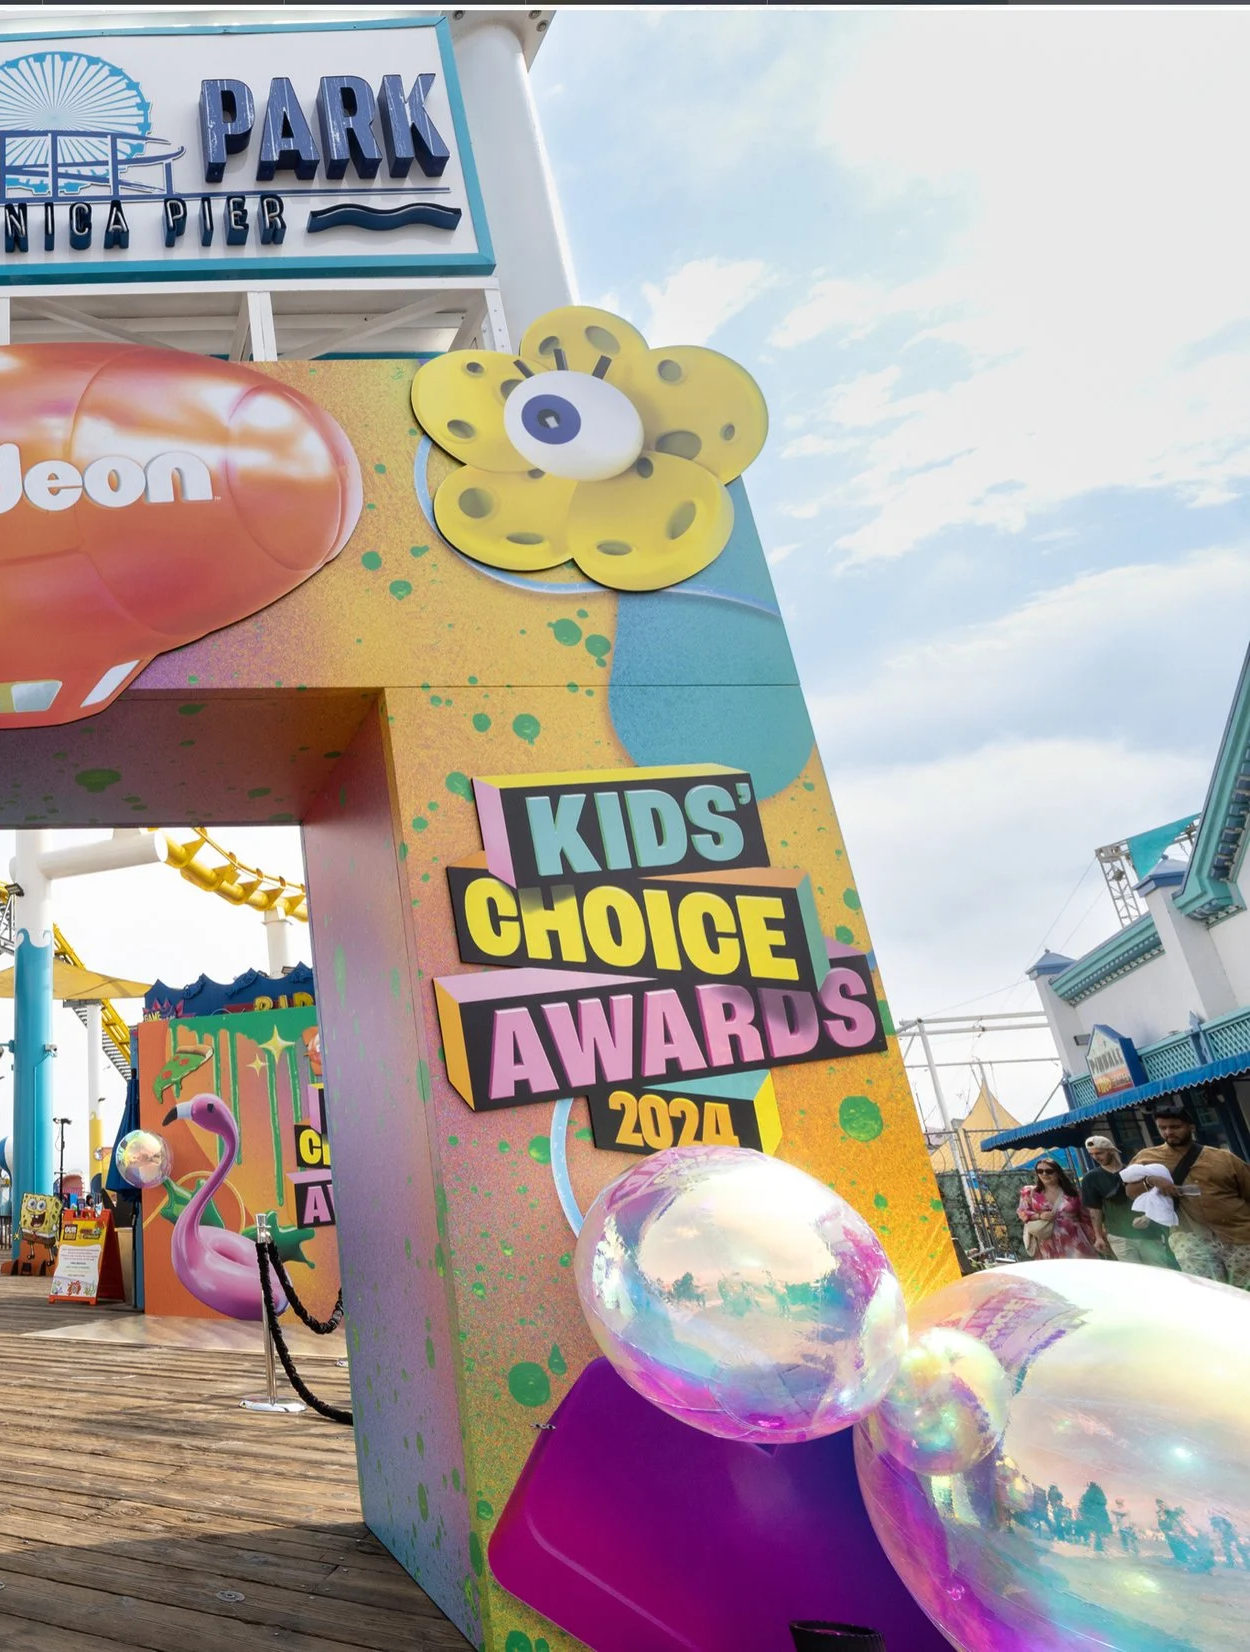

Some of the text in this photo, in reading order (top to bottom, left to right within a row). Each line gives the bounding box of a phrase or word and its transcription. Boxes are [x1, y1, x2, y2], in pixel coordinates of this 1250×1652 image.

[199, 73, 451, 184] PARK
[164, 196, 288, 248] PIER
[526, 782, 751, 877] KIDS'
[464, 877, 800, 981] CHOICE
[488, 967, 877, 1100] AWARDS
[608, 1090, 740, 1147] 2024
